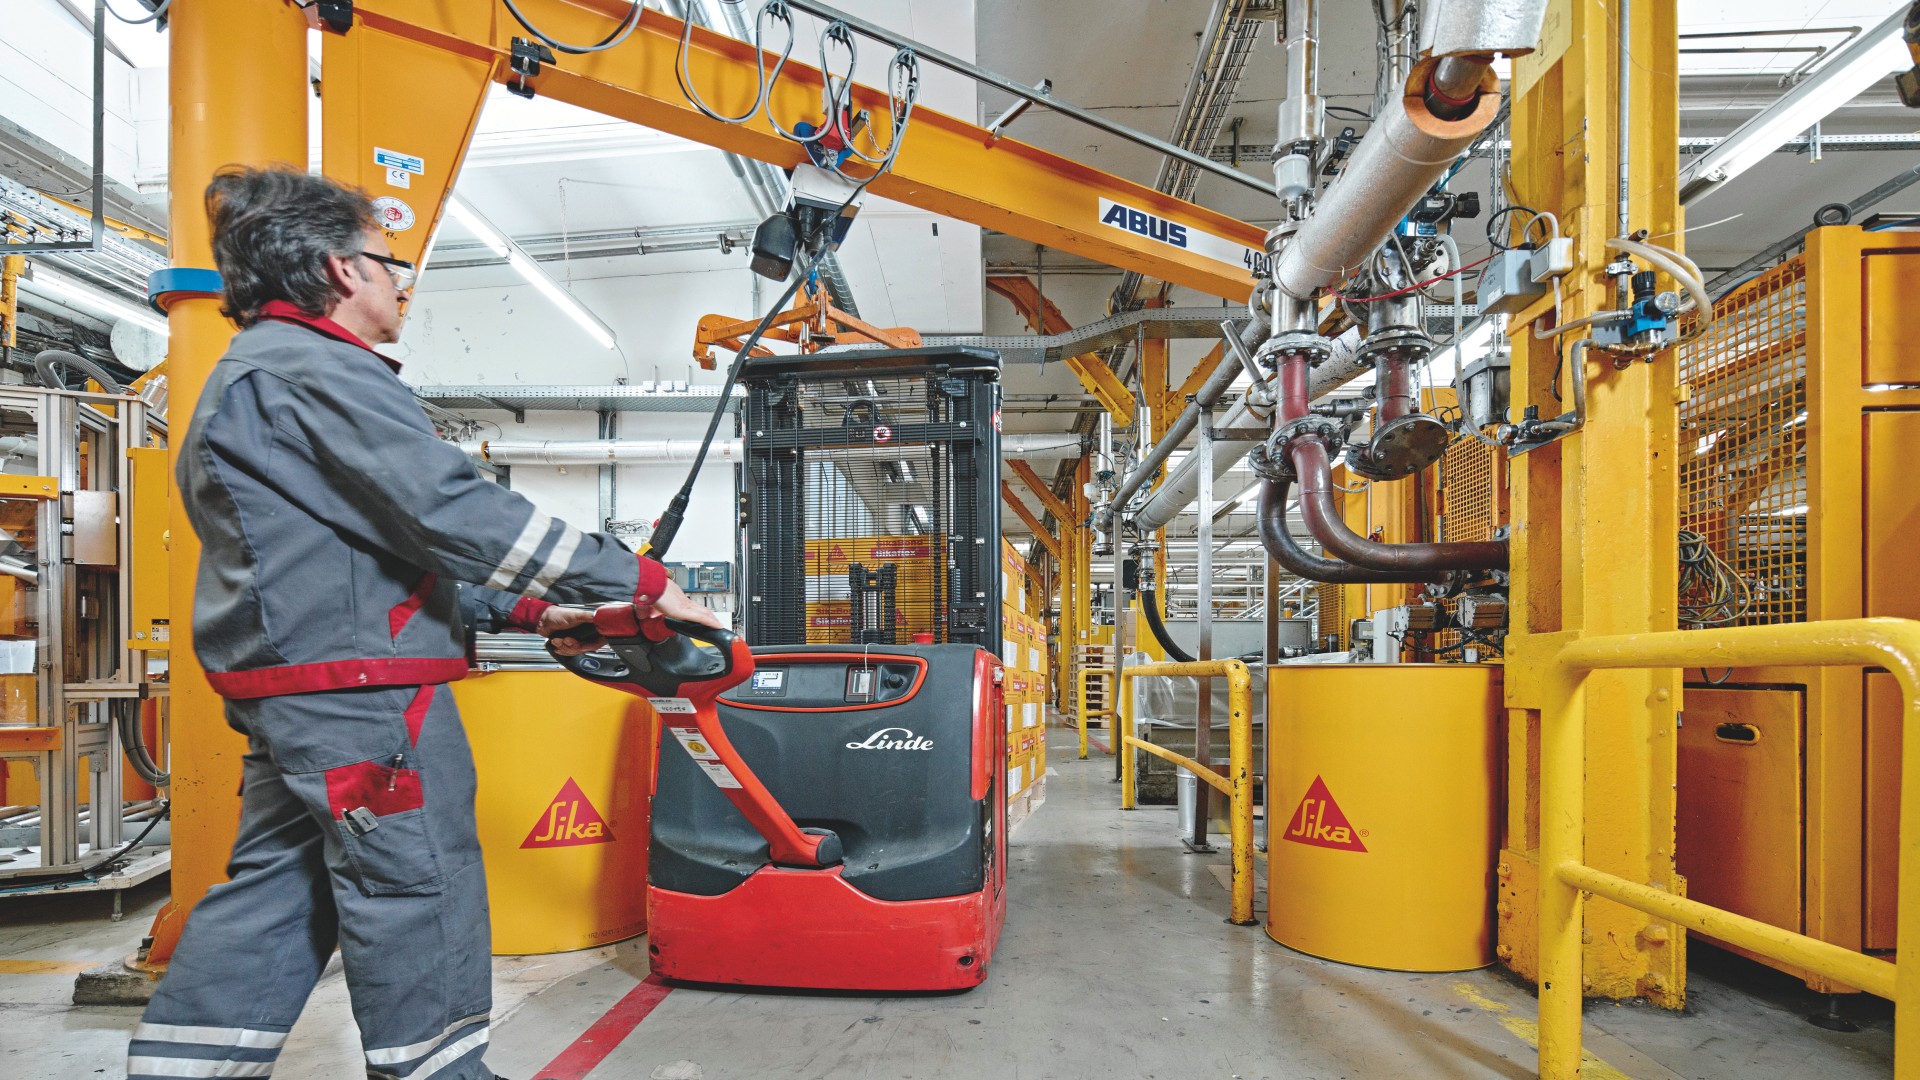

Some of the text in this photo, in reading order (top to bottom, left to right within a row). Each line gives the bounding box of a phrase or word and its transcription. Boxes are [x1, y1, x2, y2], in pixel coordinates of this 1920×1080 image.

[1101, 203, 1188, 249] ABUS
[875, 548, 916, 558] Sikaflex
[845, 727, 934, 751] Linde
[534, 800, 604, 842] Sika
[1291, 798, 1353, 844] Sika
